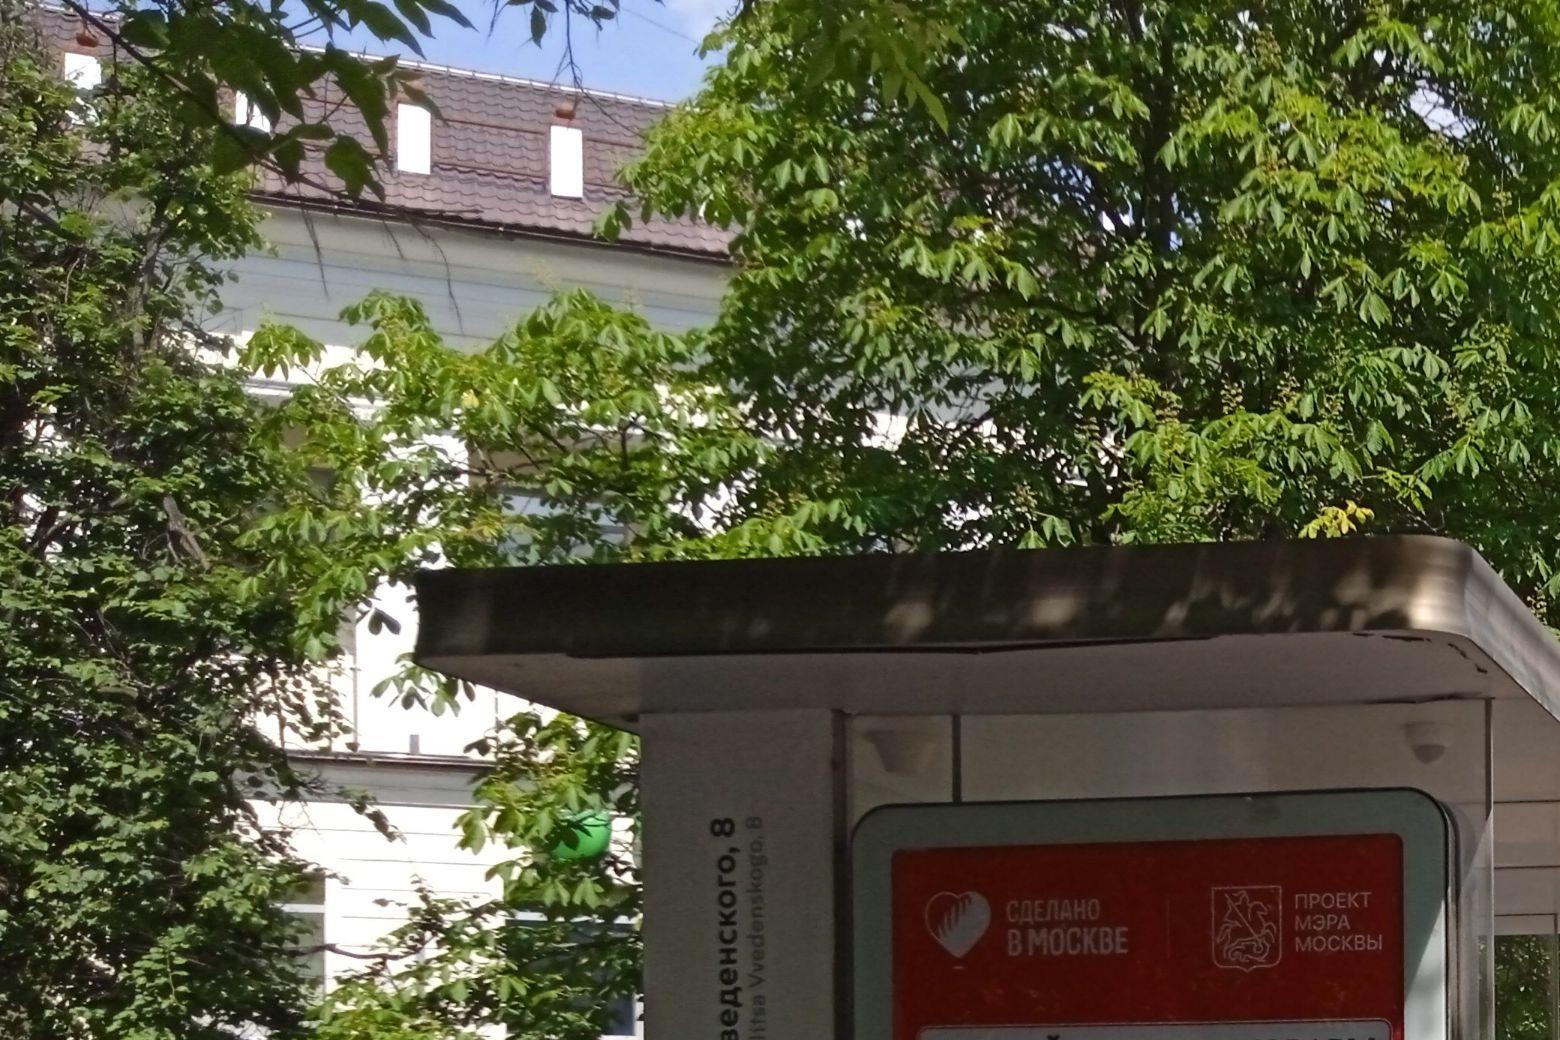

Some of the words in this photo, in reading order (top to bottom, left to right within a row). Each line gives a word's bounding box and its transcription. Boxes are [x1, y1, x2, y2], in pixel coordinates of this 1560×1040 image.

[710, 817, 736, 838] 8
[745, 816, 763, 830] 8
[1295, 891, 1372, 909] ПРОЕКТ
[745, 836, 767, 989] Vvedenskogo,
[1006, 898, 1101, 925] СДЕЛАНО
[1295, 914, 1351, 931] МЭРА
[1007, 929, 1021, 956] В
[1027, 926, 1129, 956] МОСКВЕ
[1295, 933, 1383, 952] МОСКВЫ
